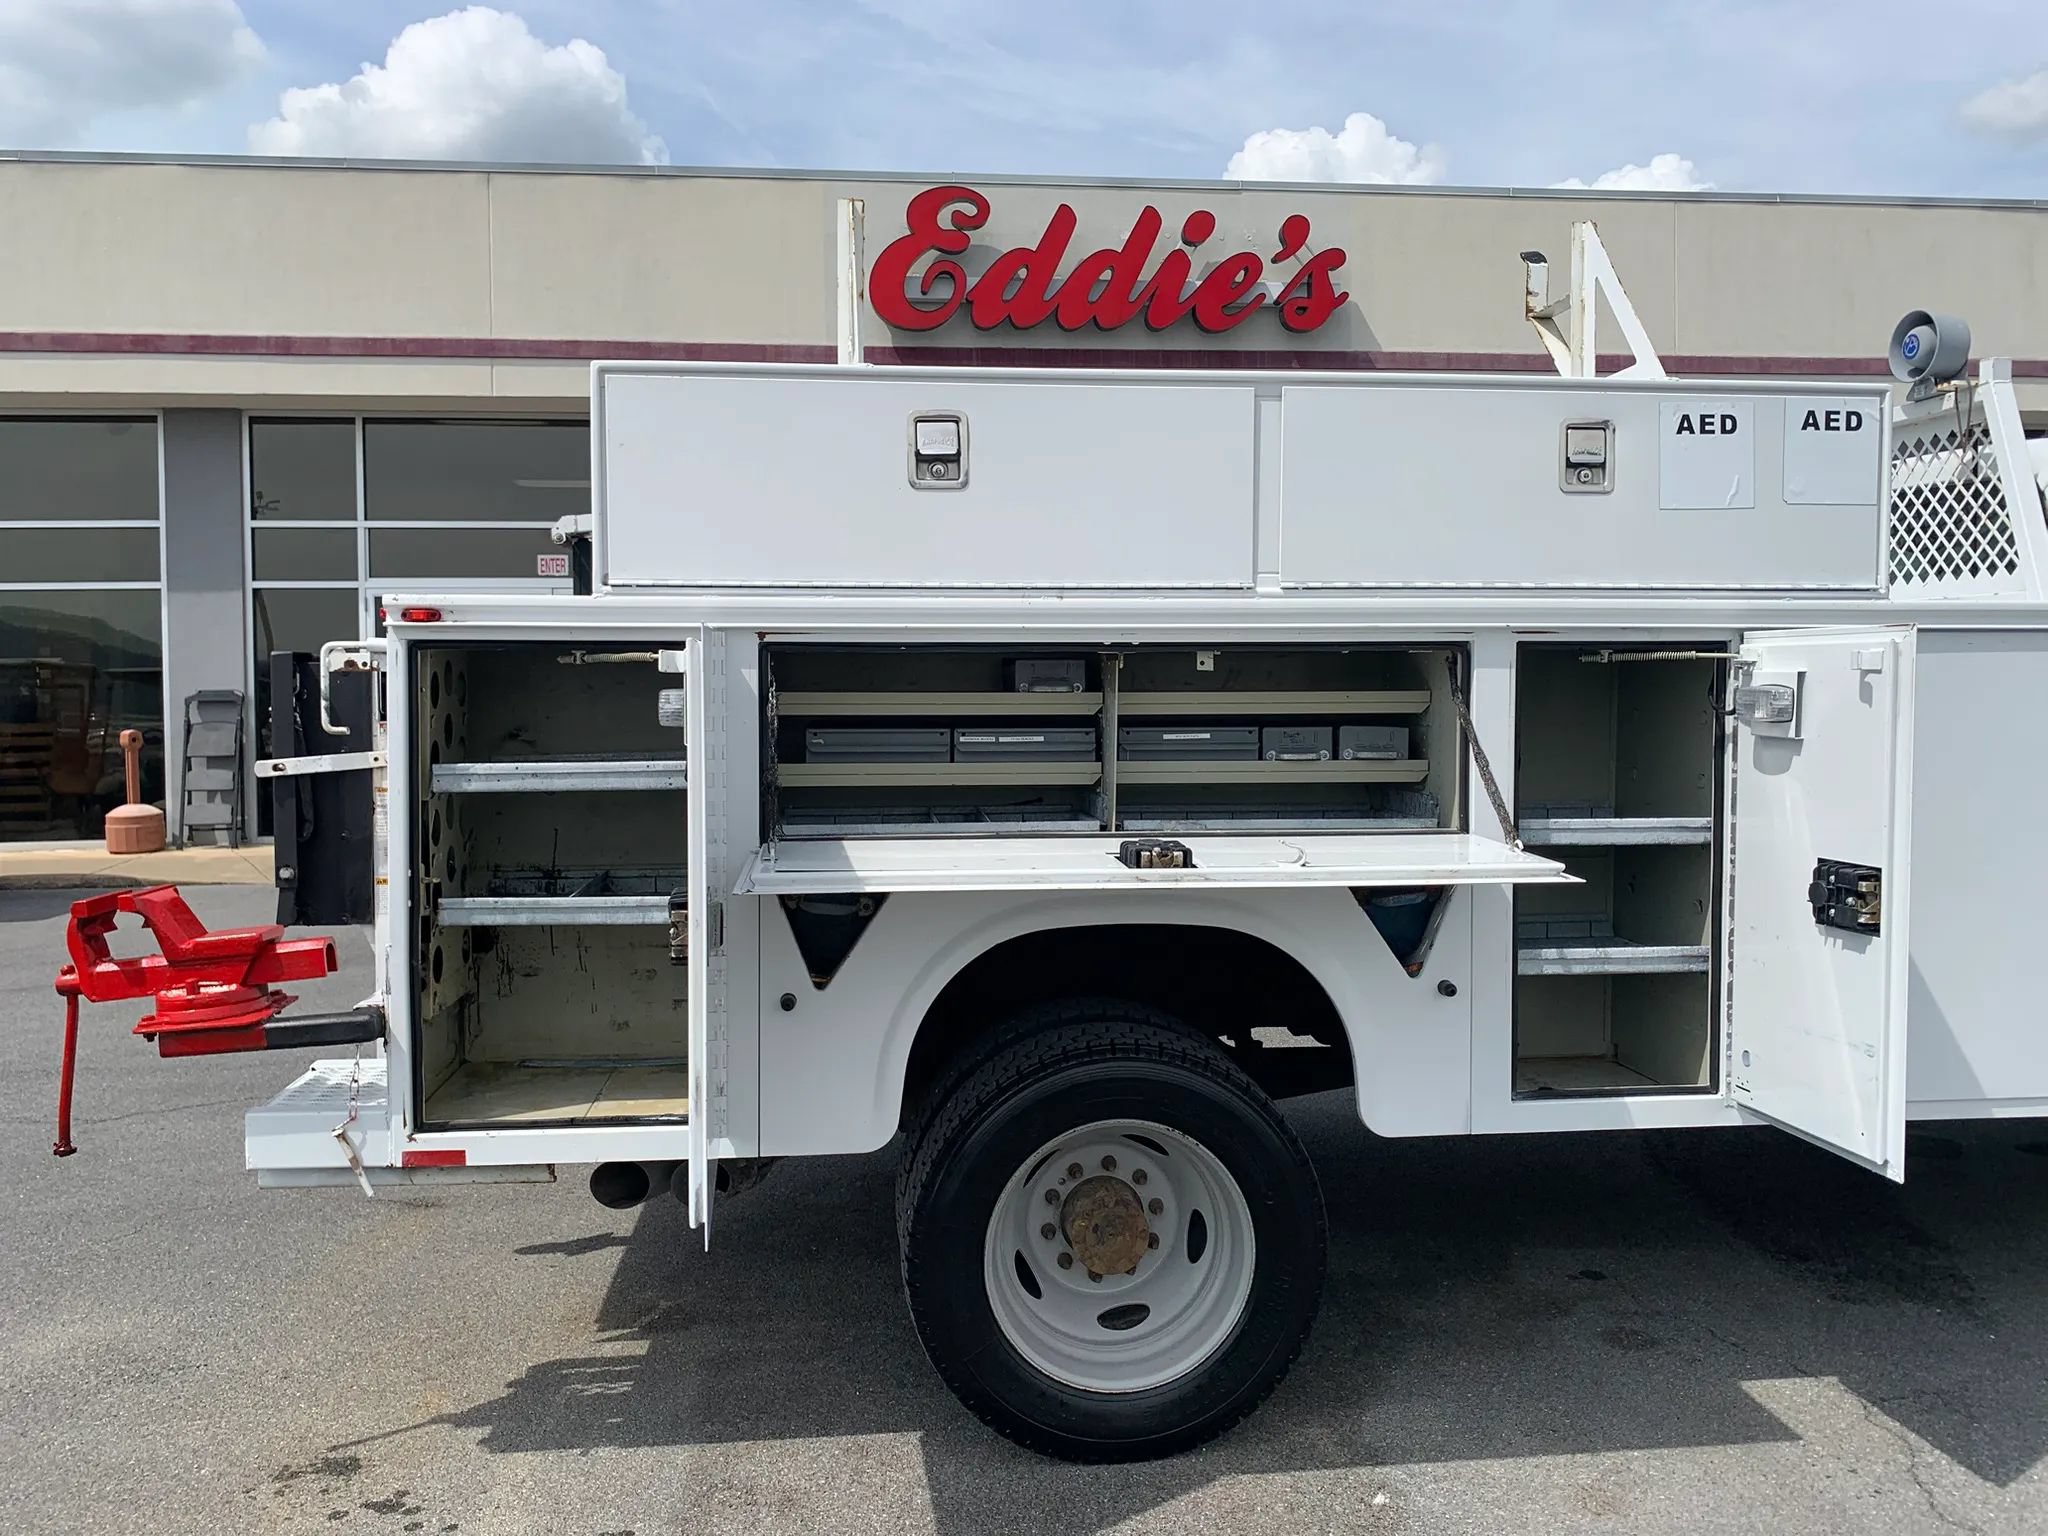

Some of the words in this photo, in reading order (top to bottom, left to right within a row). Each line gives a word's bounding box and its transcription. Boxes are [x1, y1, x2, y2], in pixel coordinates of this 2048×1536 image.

[869, 186, 1349, 332] Eddie's
[1676, 413, 1737, 435] AED
[1801, 409, 1863, 431] AED
[540, 558, 566, 573] ENTER
